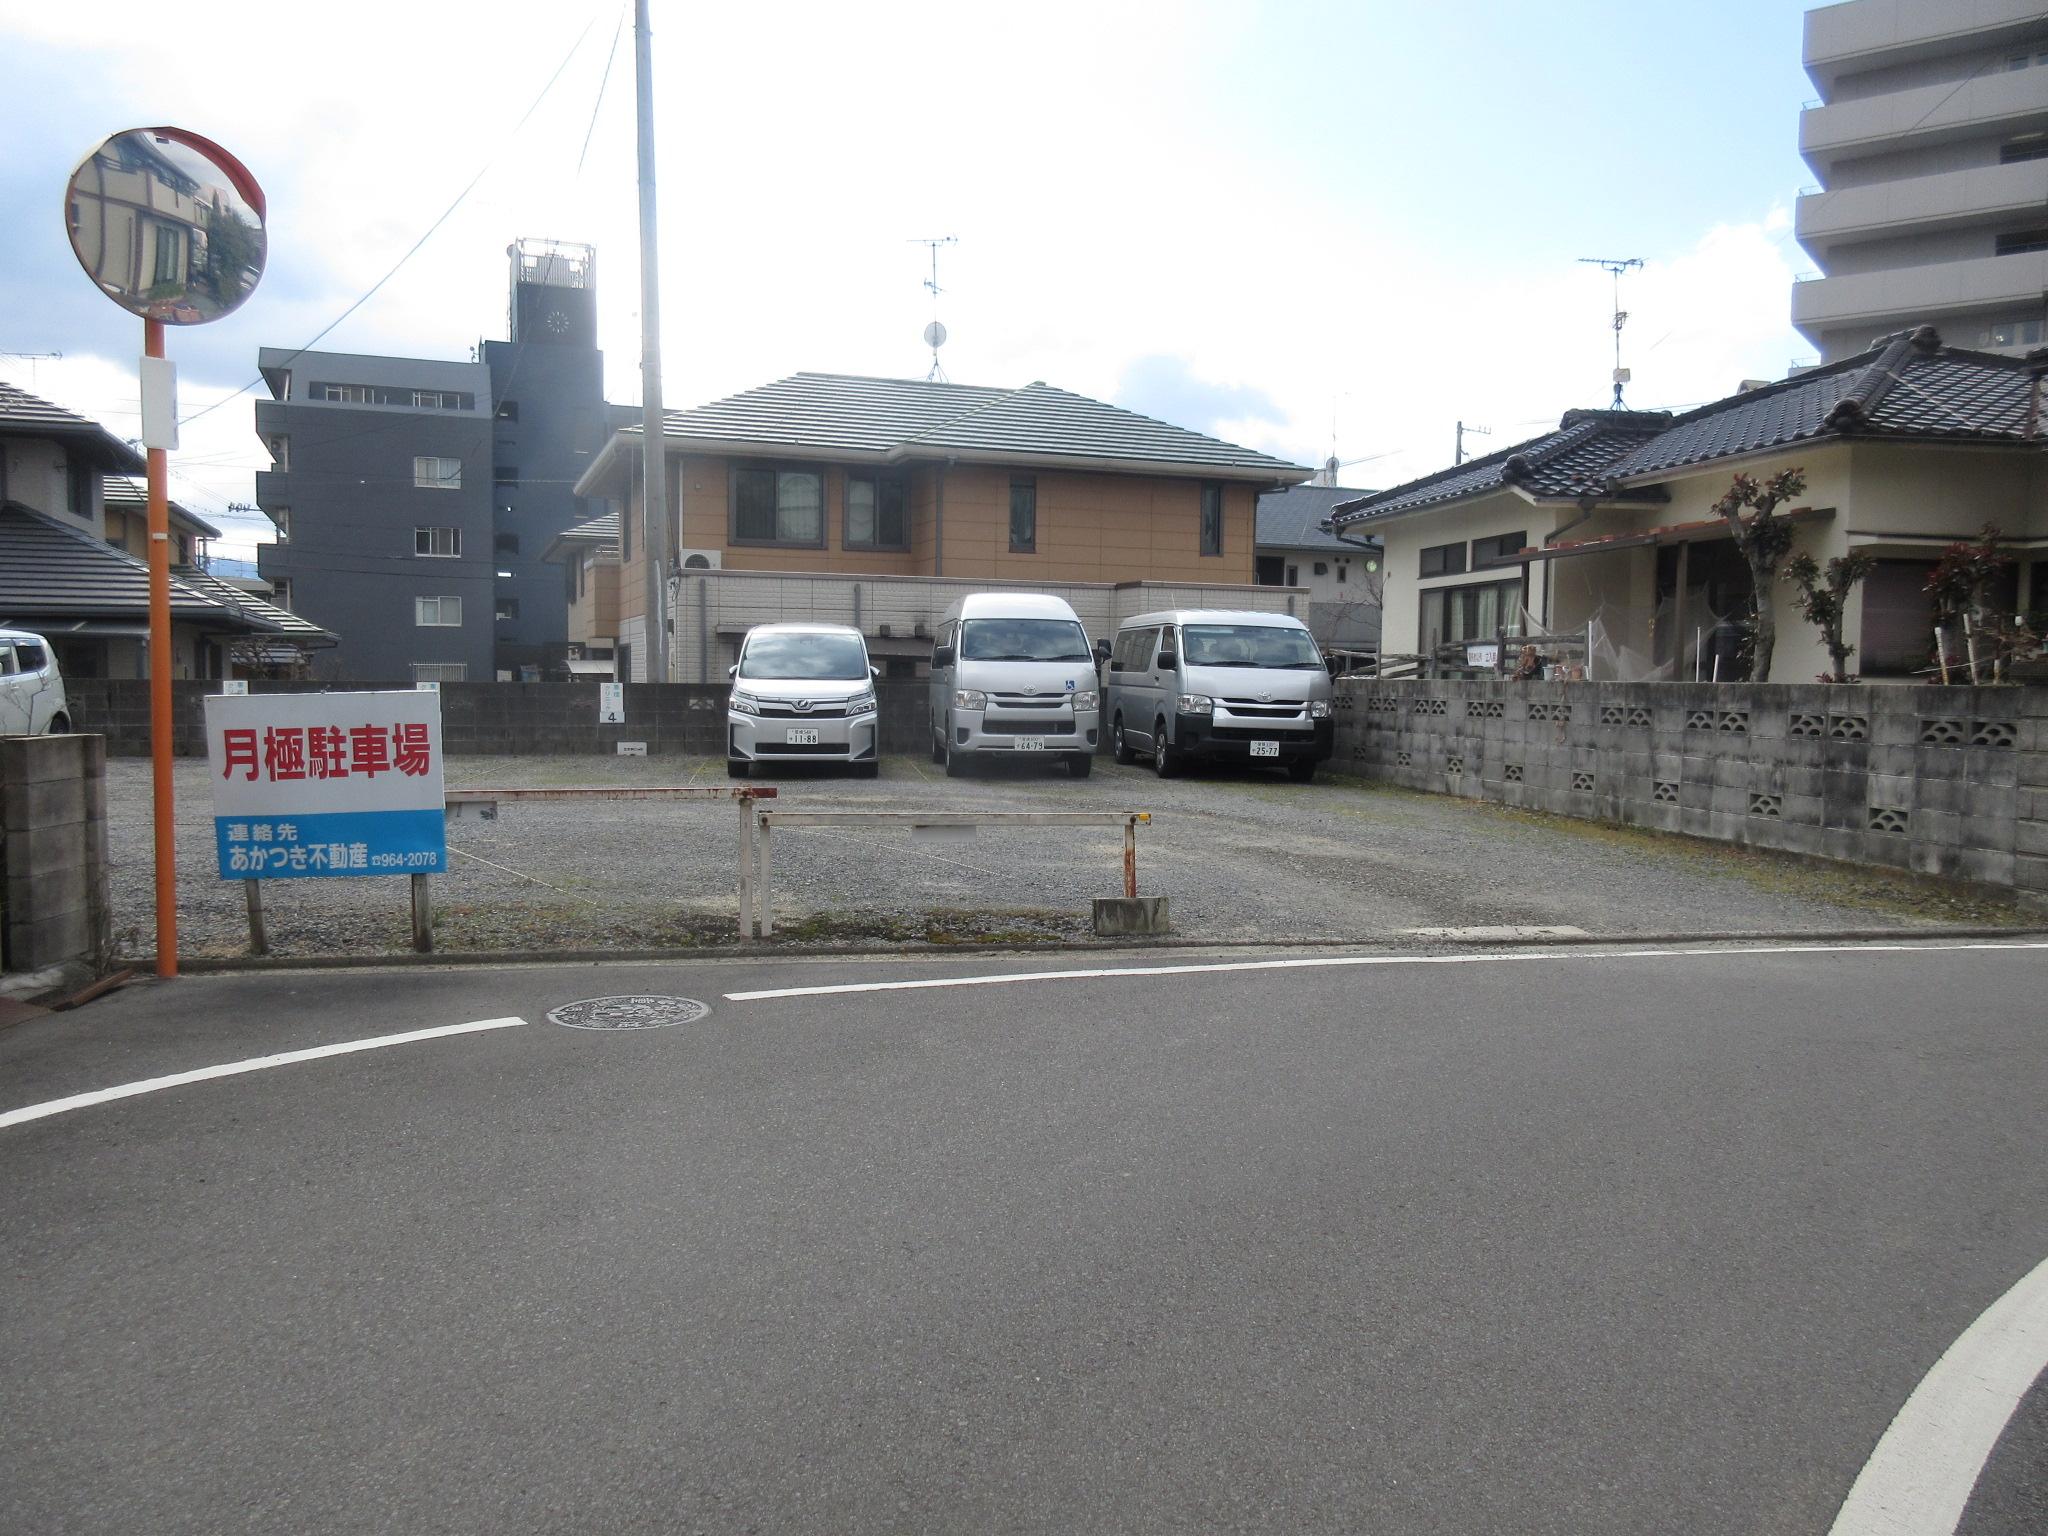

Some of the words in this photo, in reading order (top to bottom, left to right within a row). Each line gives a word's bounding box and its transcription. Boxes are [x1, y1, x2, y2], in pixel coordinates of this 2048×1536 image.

[608, 712, 617, 722] 4
[222, 723, 431, 782] 月極駐車場
[228, 823, 298, 842] 連絡先
[230, 842, 368, 871] あかつき不動産
